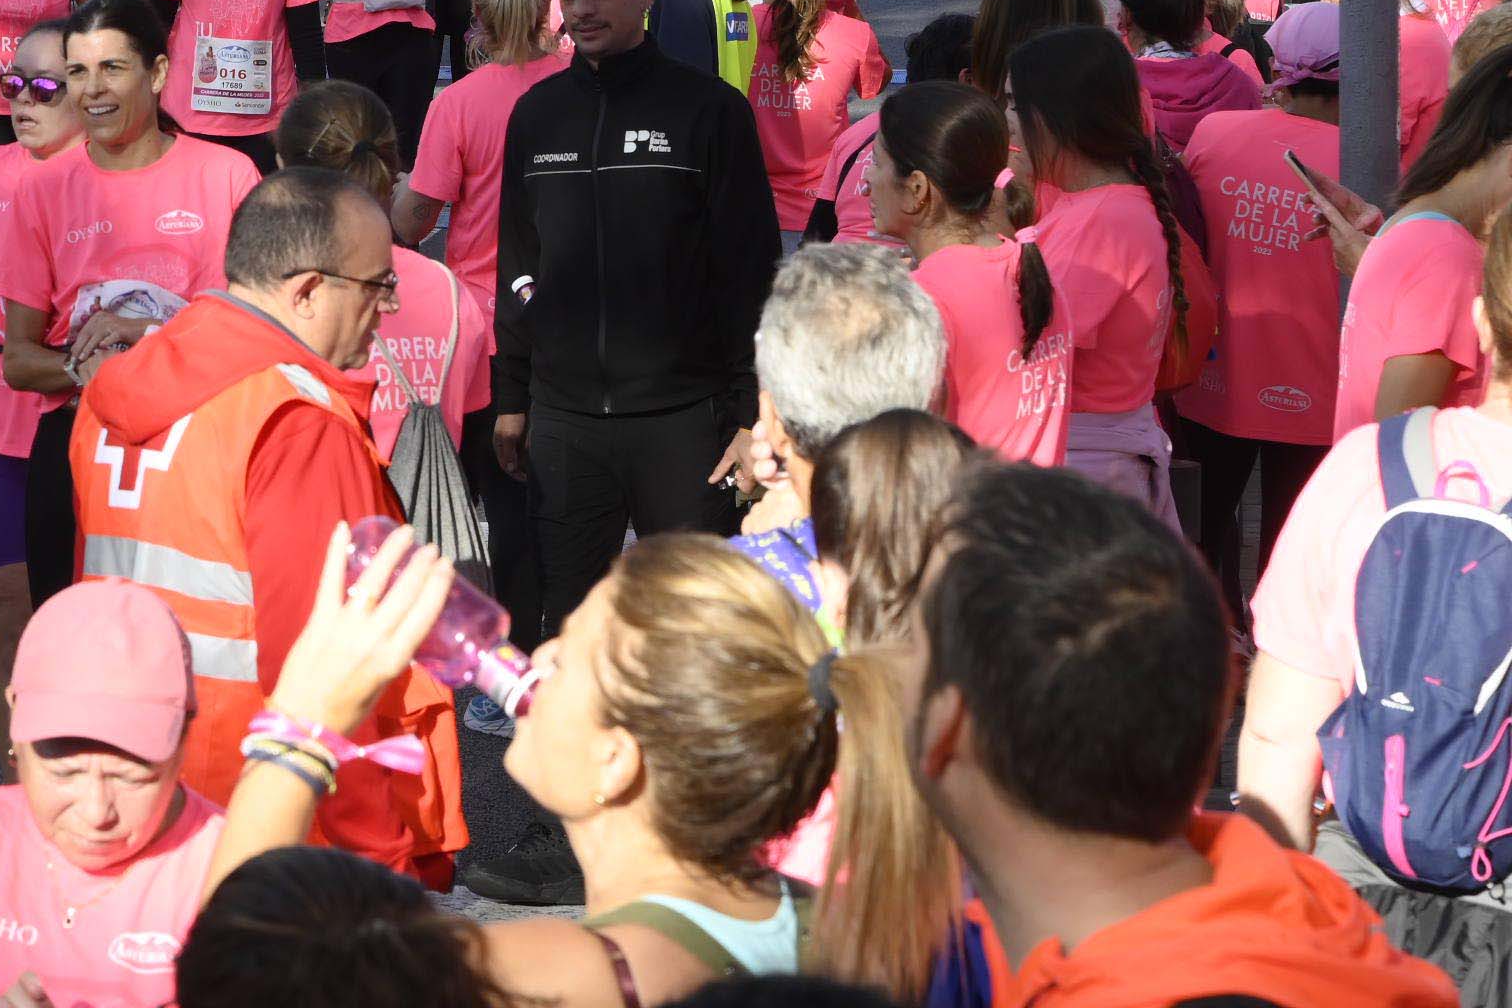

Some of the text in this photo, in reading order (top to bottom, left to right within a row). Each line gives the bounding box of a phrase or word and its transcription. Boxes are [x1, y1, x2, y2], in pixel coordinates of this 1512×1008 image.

[219, 68, 247, 80] 016
[222, 81, 243, 90] 17689
[761, 78, 782, 94] DE
[756, 95, 812, 111] MUJER
[533, 152, 579, 164] COORDINADOR
[1234, 199, 1300, 232] DE LA
[1227, 220, 1301, 252] MUJER
[411, 360, 437, 385] LA
[1021, 366, 1043, 394] DE
